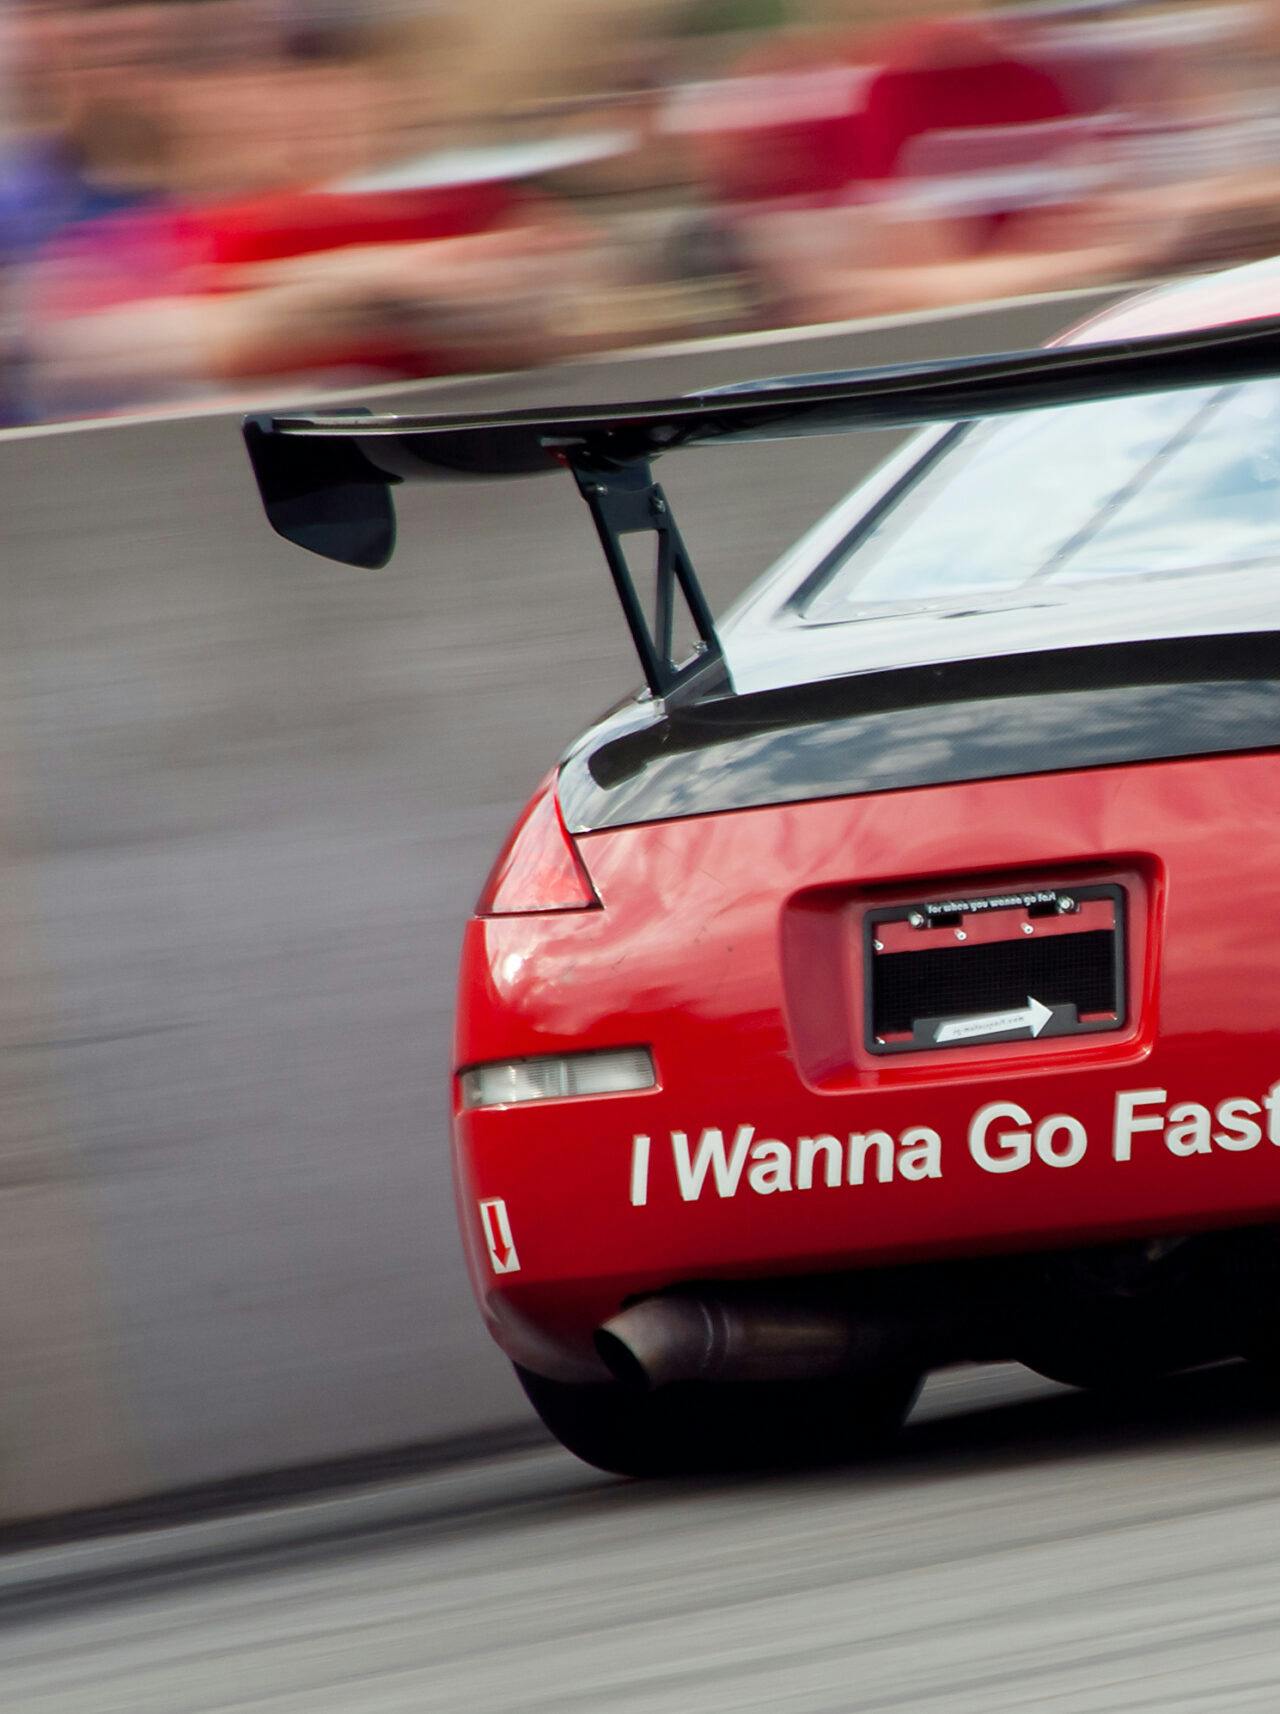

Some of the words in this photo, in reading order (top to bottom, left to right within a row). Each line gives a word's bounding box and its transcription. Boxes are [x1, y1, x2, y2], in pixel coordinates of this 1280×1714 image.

[943, 901, 969, 913] when
[971, 899, 988, 912] you
[989, 896, 1022, 908] wanna
[1024, 894, 1037, 906] go
[1037, 890, 1057, 902] fast
[630, 1136, 651, 1206] I
[671, 1124, 942, 1201] Wanna
[969, 1102, 1088, 1173] Go
